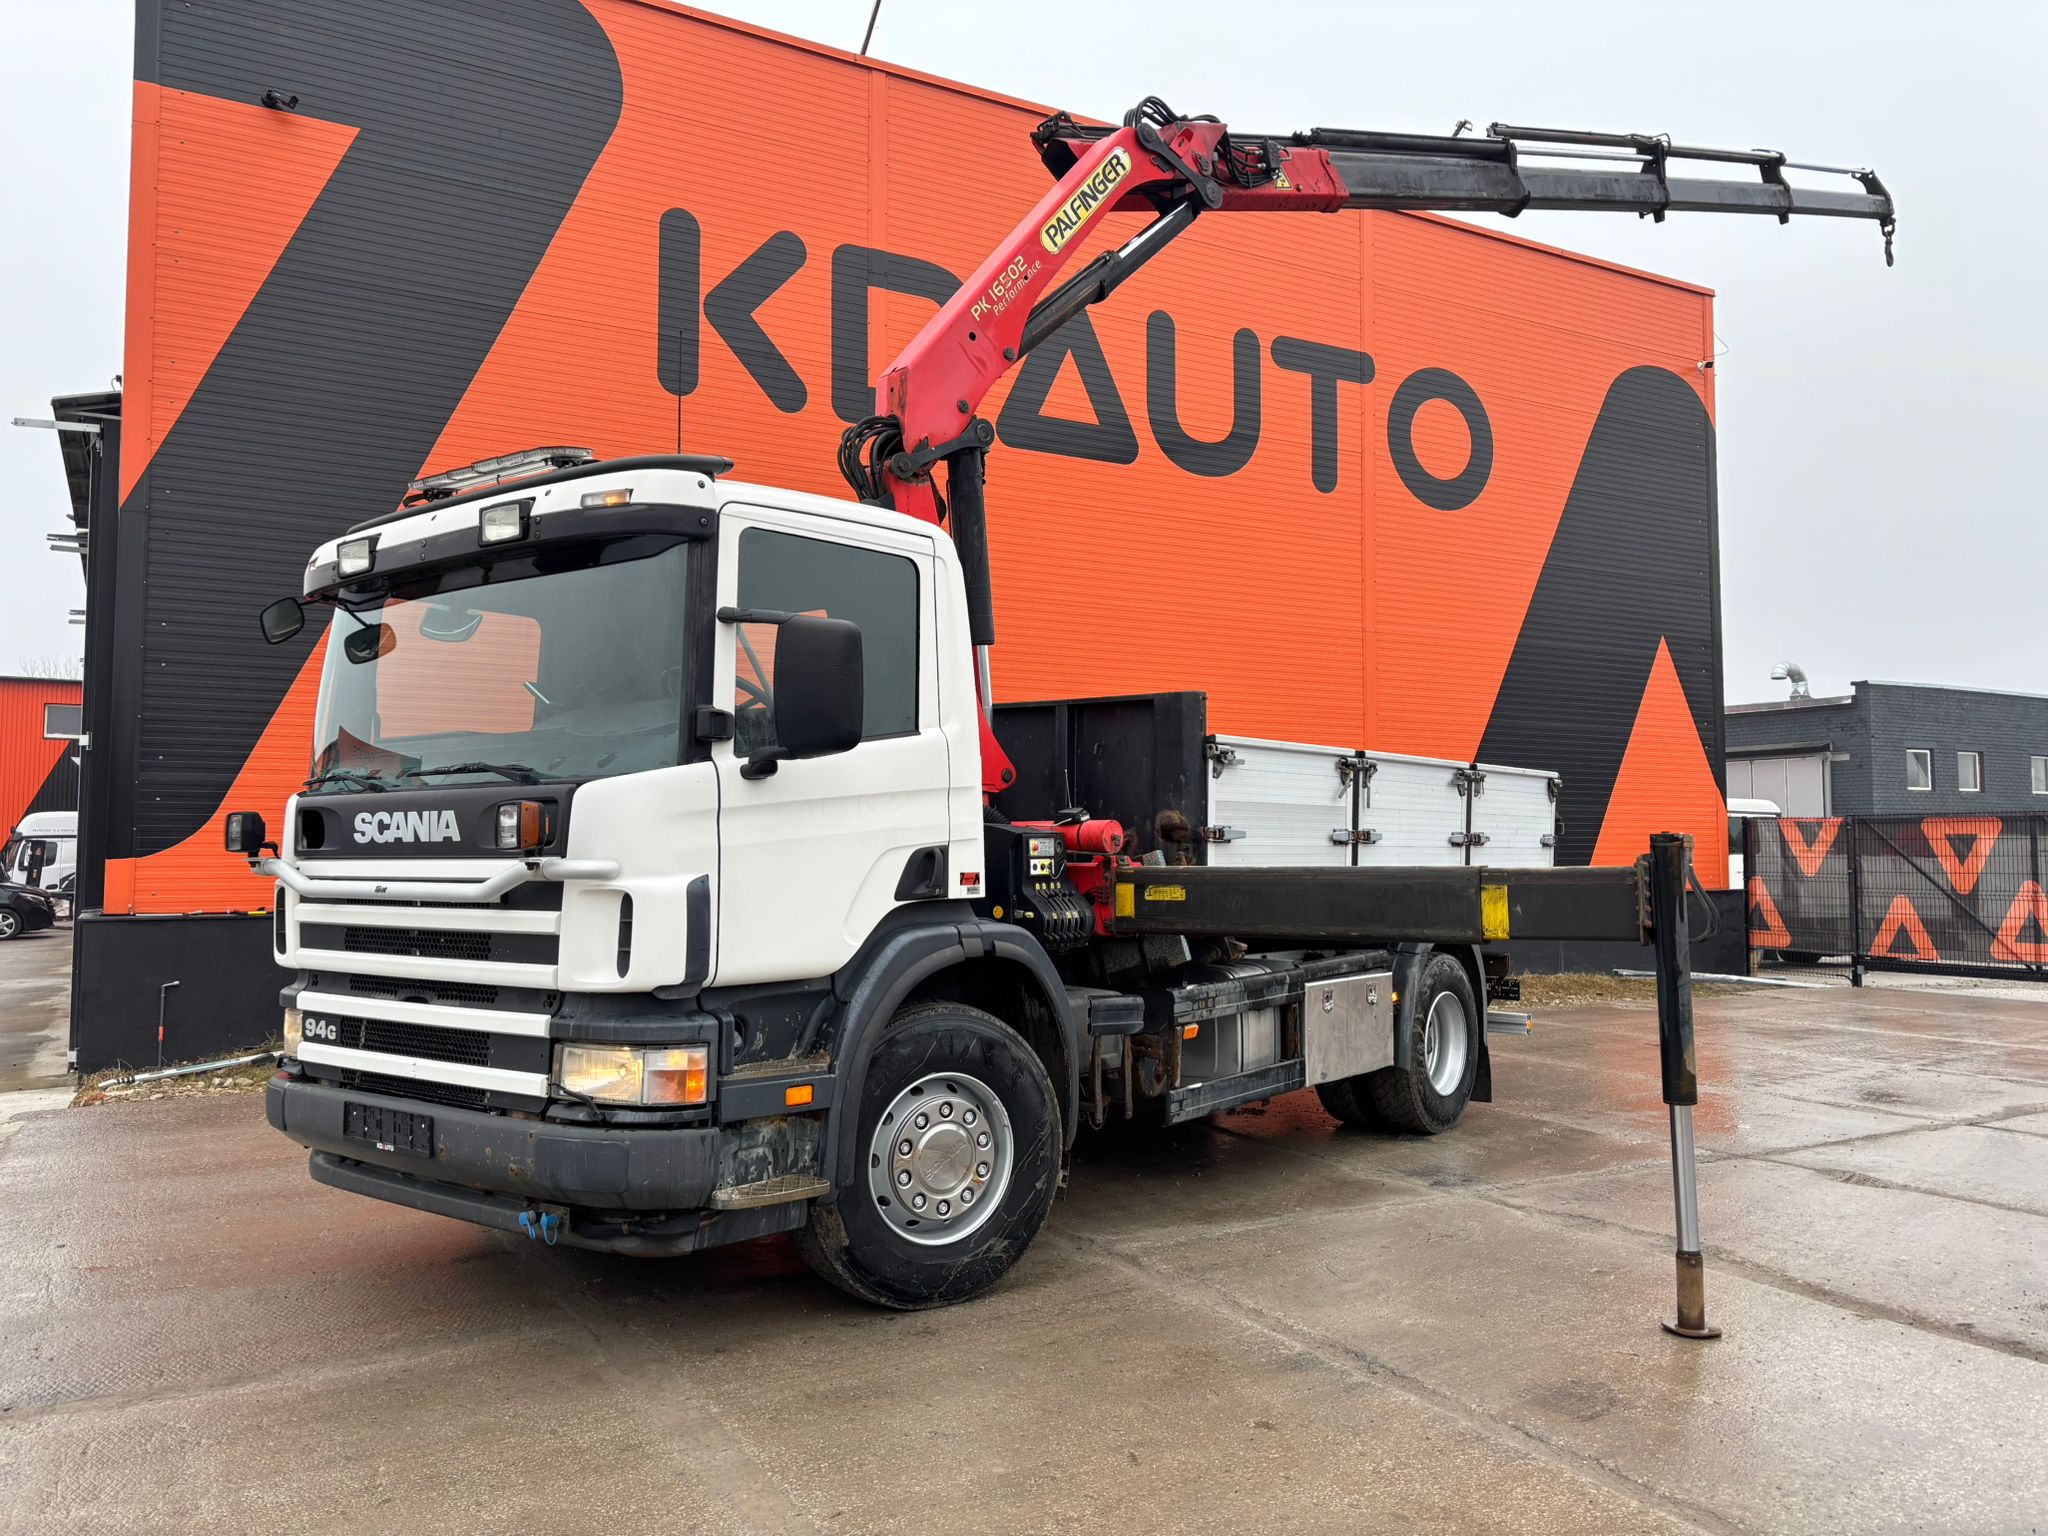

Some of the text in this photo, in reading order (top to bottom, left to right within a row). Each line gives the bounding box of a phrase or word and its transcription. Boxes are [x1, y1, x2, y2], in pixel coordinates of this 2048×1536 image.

[1044, 153, 1127, 248] PALFINGER
[970, 255, 1028, 322] PK 16502
[992, 260, 1041, 317] Performance
[353, 809, 462, 844] SCANIA
[304, 1017, 337, 1040] 94G
